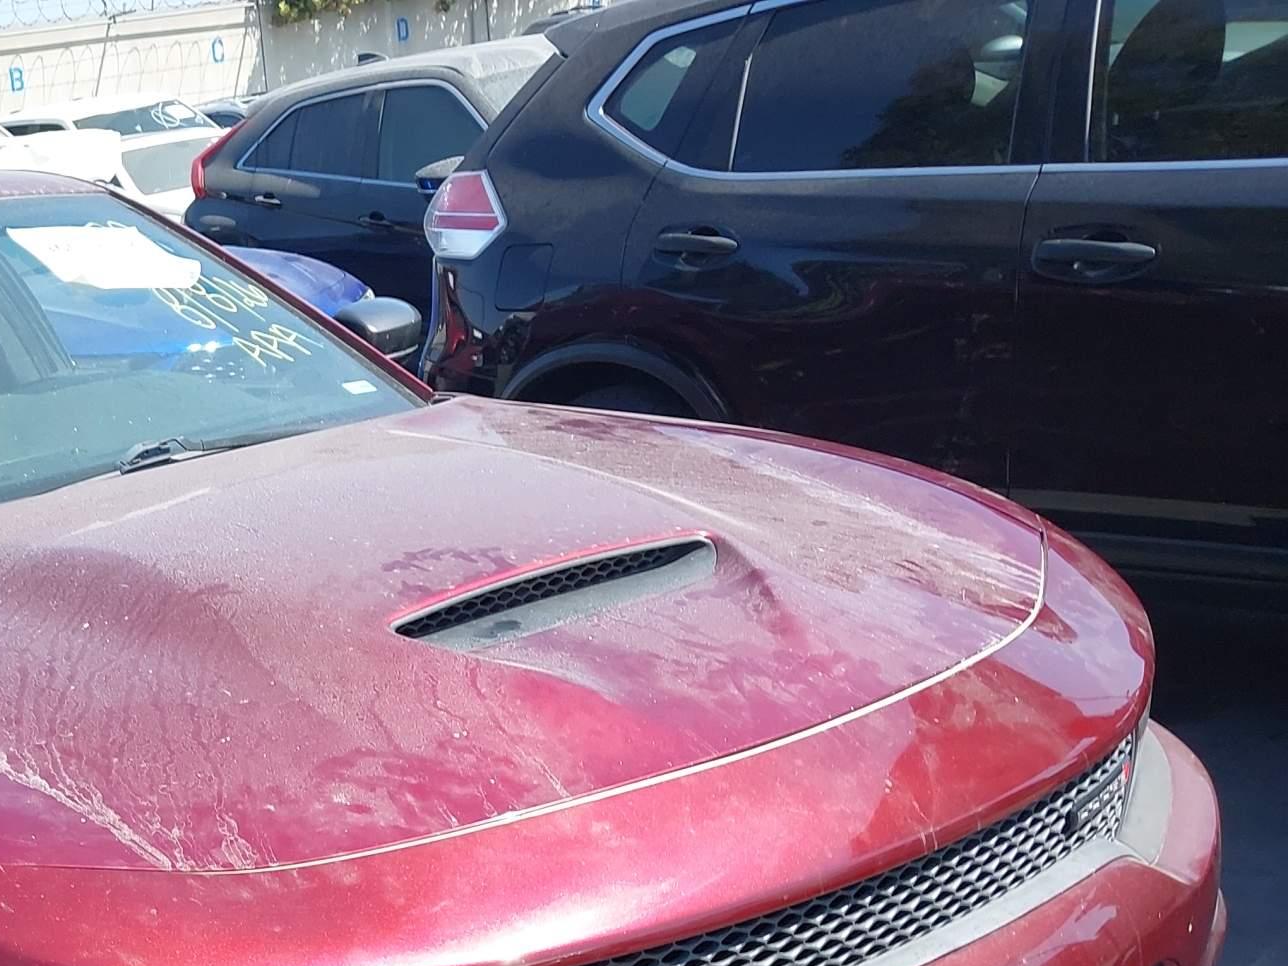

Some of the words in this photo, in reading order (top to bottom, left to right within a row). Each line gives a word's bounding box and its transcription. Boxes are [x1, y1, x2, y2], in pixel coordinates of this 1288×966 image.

[396, 17, 409, 42] D
[212, 36, 224, 63] C
[9, 67, 24, 92] B
